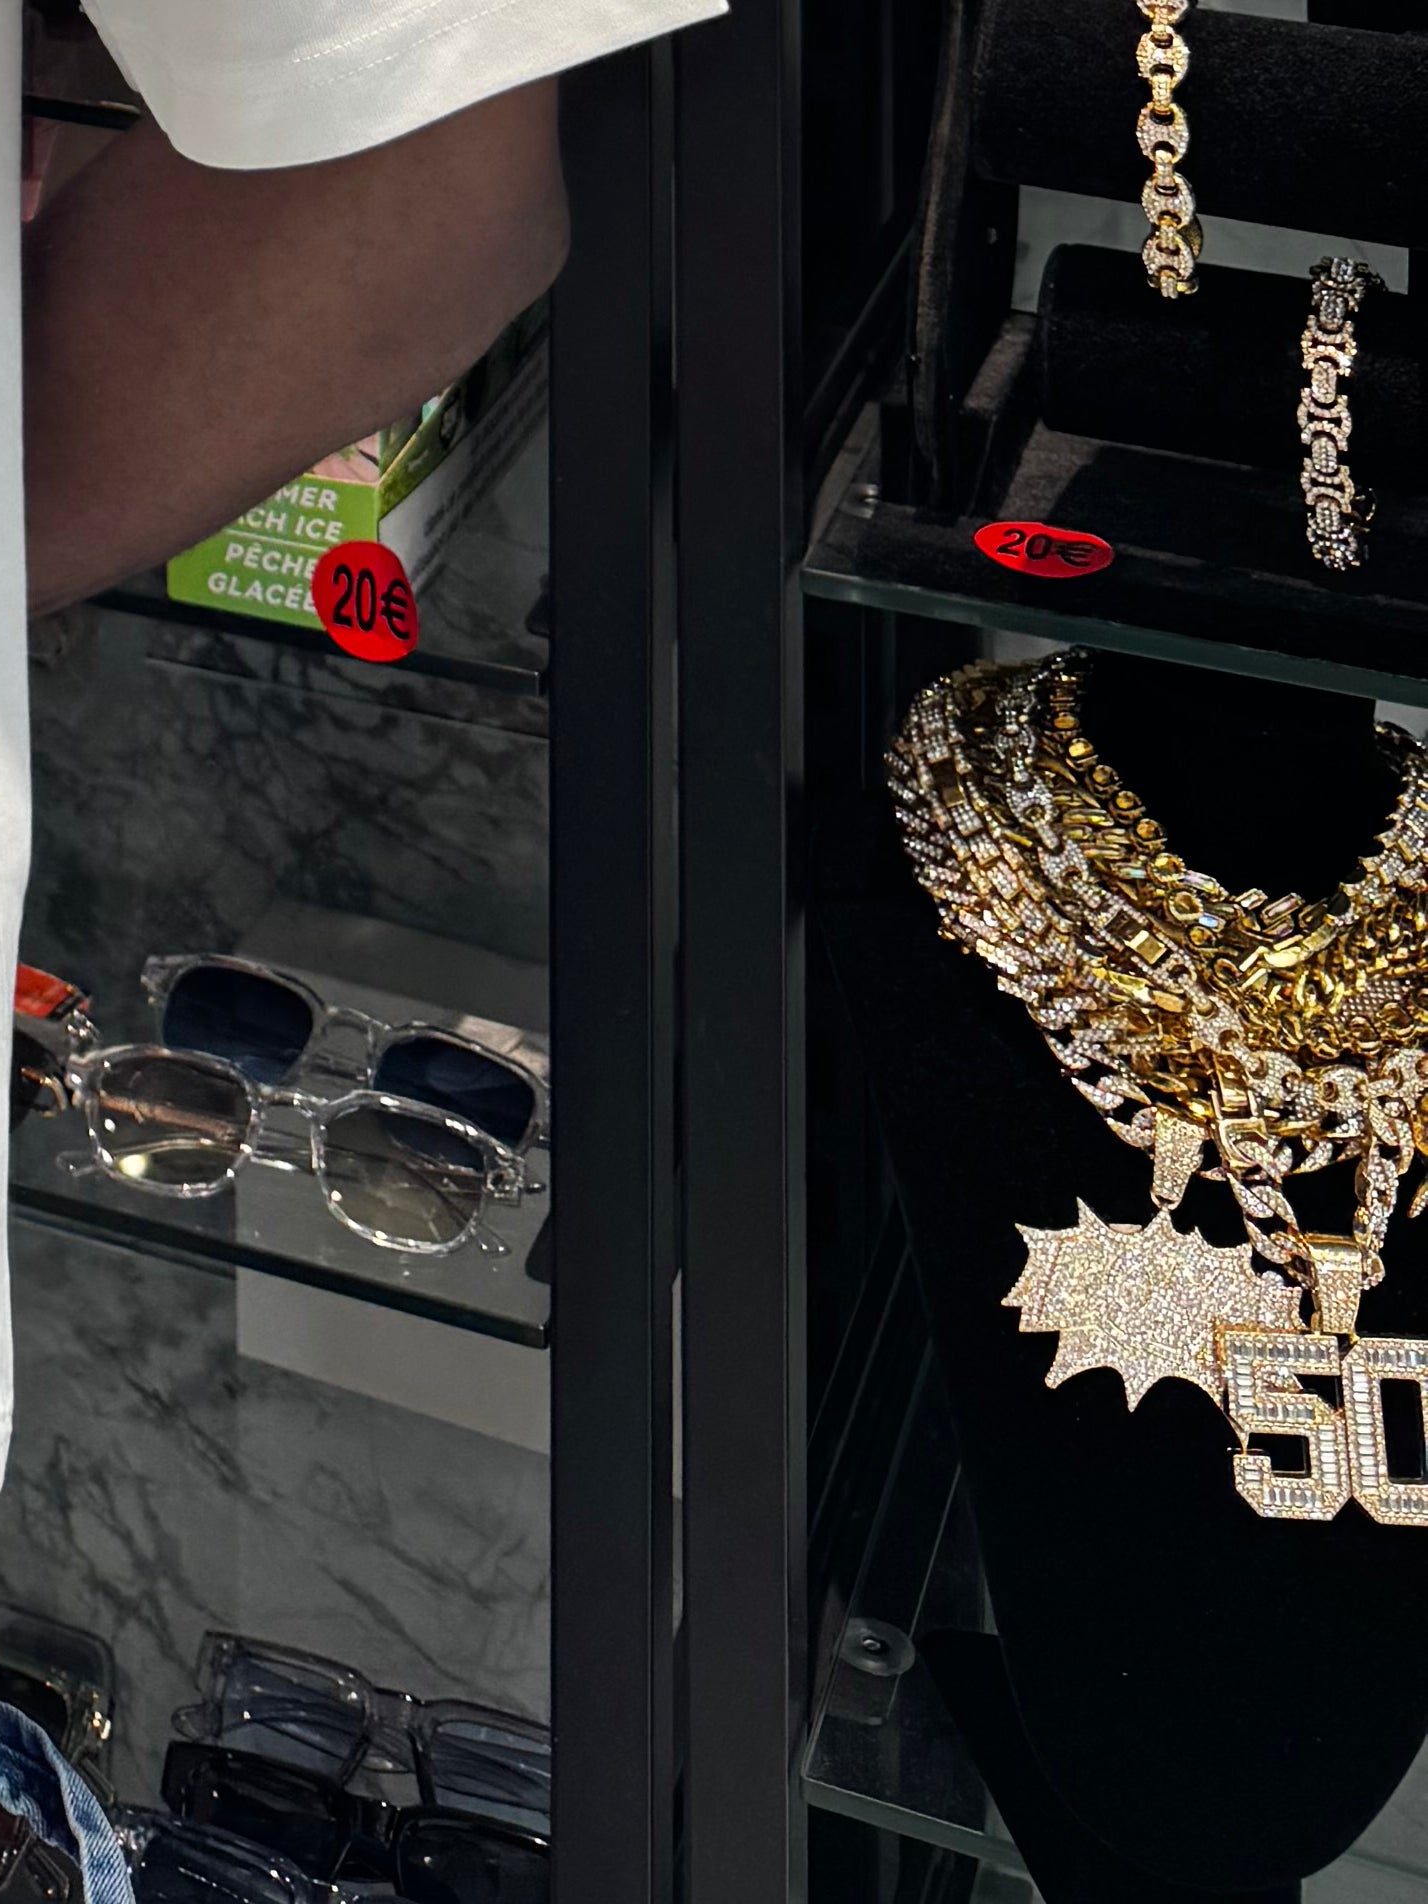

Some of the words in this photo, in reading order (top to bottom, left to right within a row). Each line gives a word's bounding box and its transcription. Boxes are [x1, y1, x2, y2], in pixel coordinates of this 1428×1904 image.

[274, 484, 339, 512] MER
[295, 515, 344, 543] ICE
[995, 528, 1096, 568] 20€
[224, 541, 318, 580] PÊCHE
[332, 563, 411, 641] 20€
